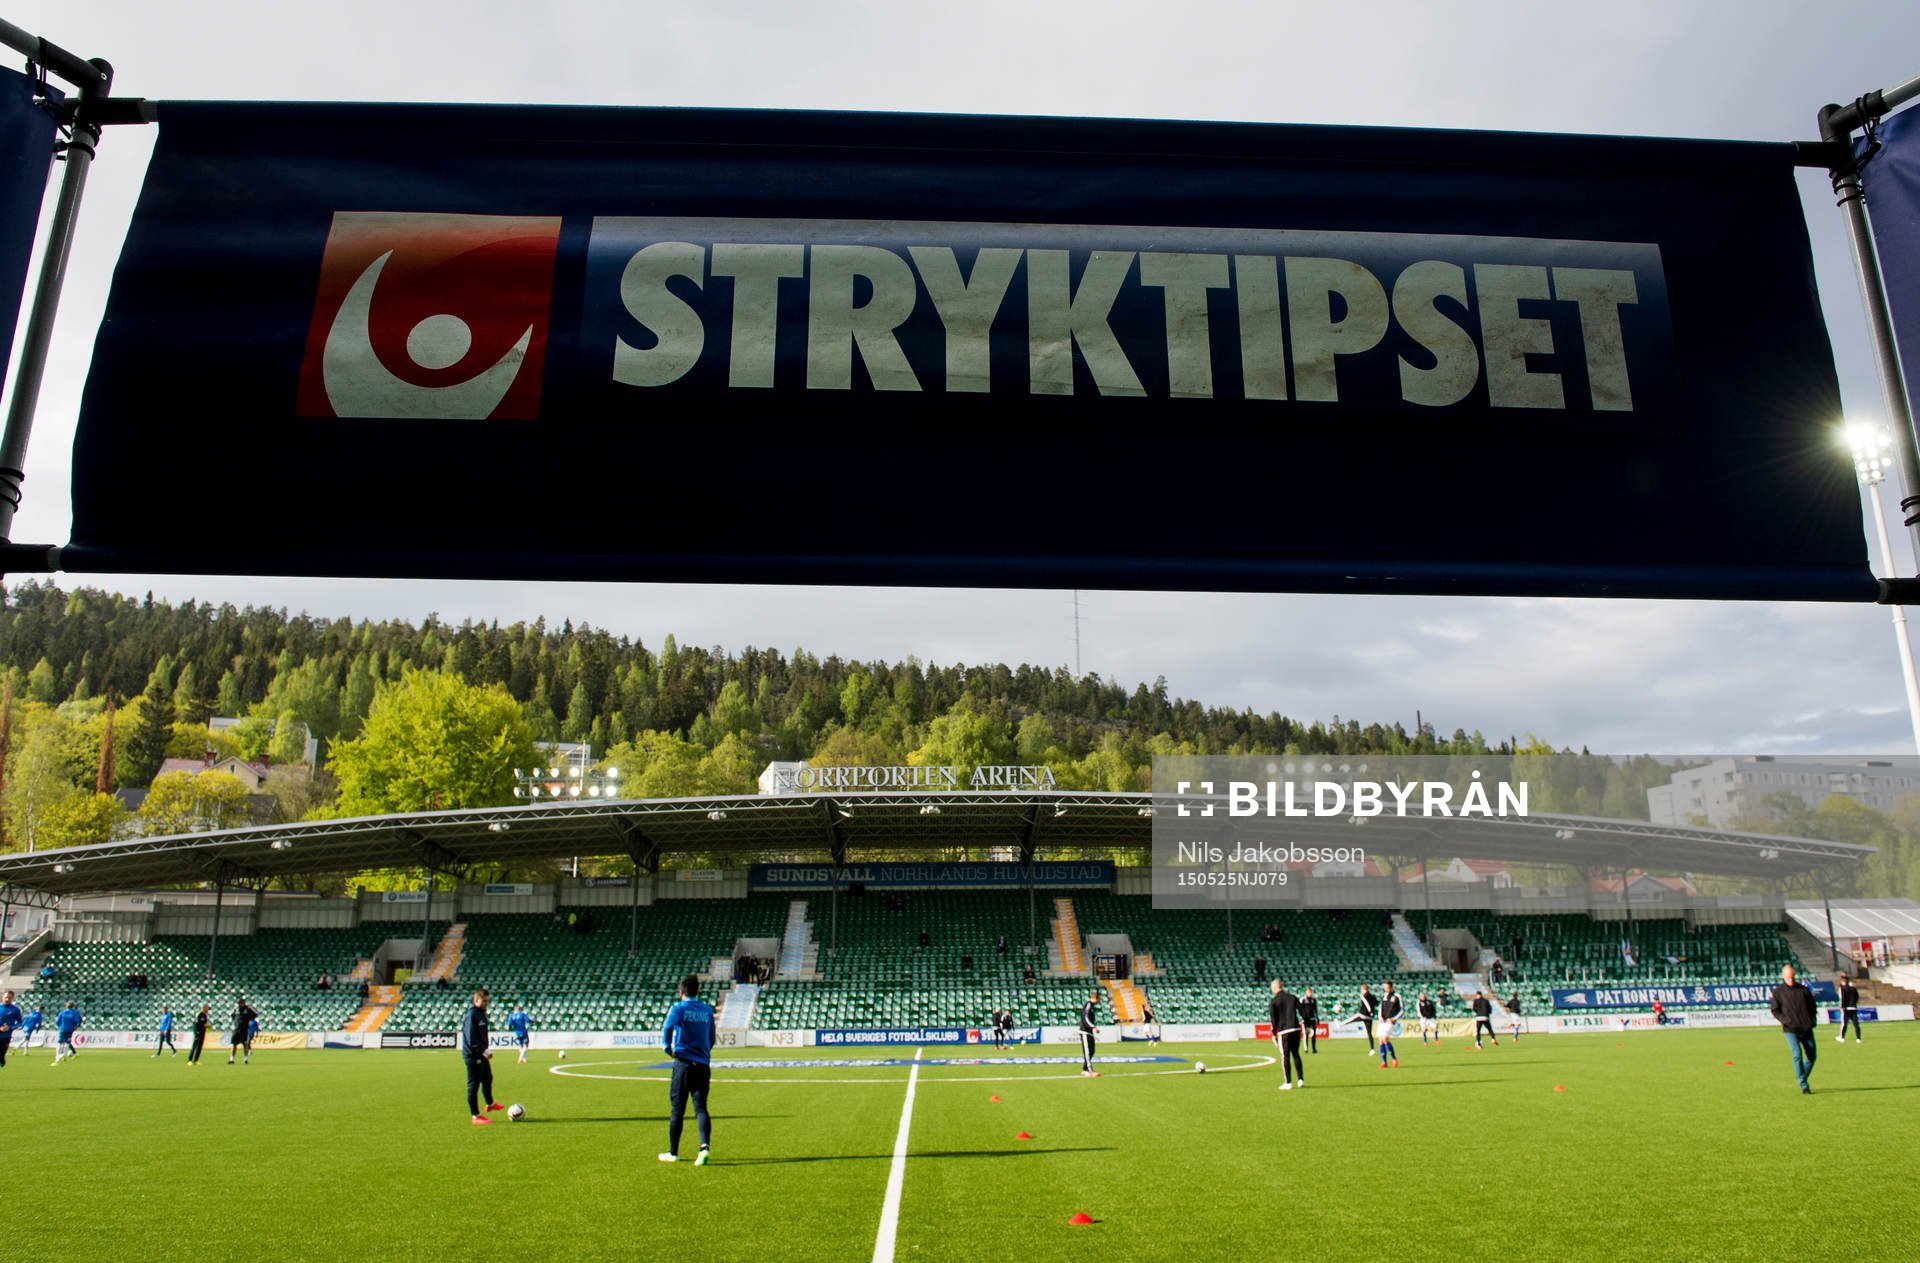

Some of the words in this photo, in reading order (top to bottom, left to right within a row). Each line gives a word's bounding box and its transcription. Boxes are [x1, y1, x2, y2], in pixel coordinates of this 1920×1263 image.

[611, 240, 1640, 413] STRYKTIPSET
[772, 765, 957, 788] NORRPORTEN
[970, 765, 1057, 786] ARENA
[766, 867, 875, 882] SUNDSVALL
[880, 866, 988, 881] NORRLANDS
[993, 864, 1101, 880] HUVUDSTAD
[1595, 987, 1688, 1005] PATRONERNA
[1714, 985, 1775, 1002] SUNDSVA
[683, 1010, 710, 1022] PEKING
[1406, 1022, 1455, 1033] POEN!
[411, 1034, 456, 1047] adidas
[821, 1032, 844, 1043] HELA
[845, 1031, 887, 1043] SVERIGES
[888, 1031, 960, 1042] FOTBOLLSKLUBB
